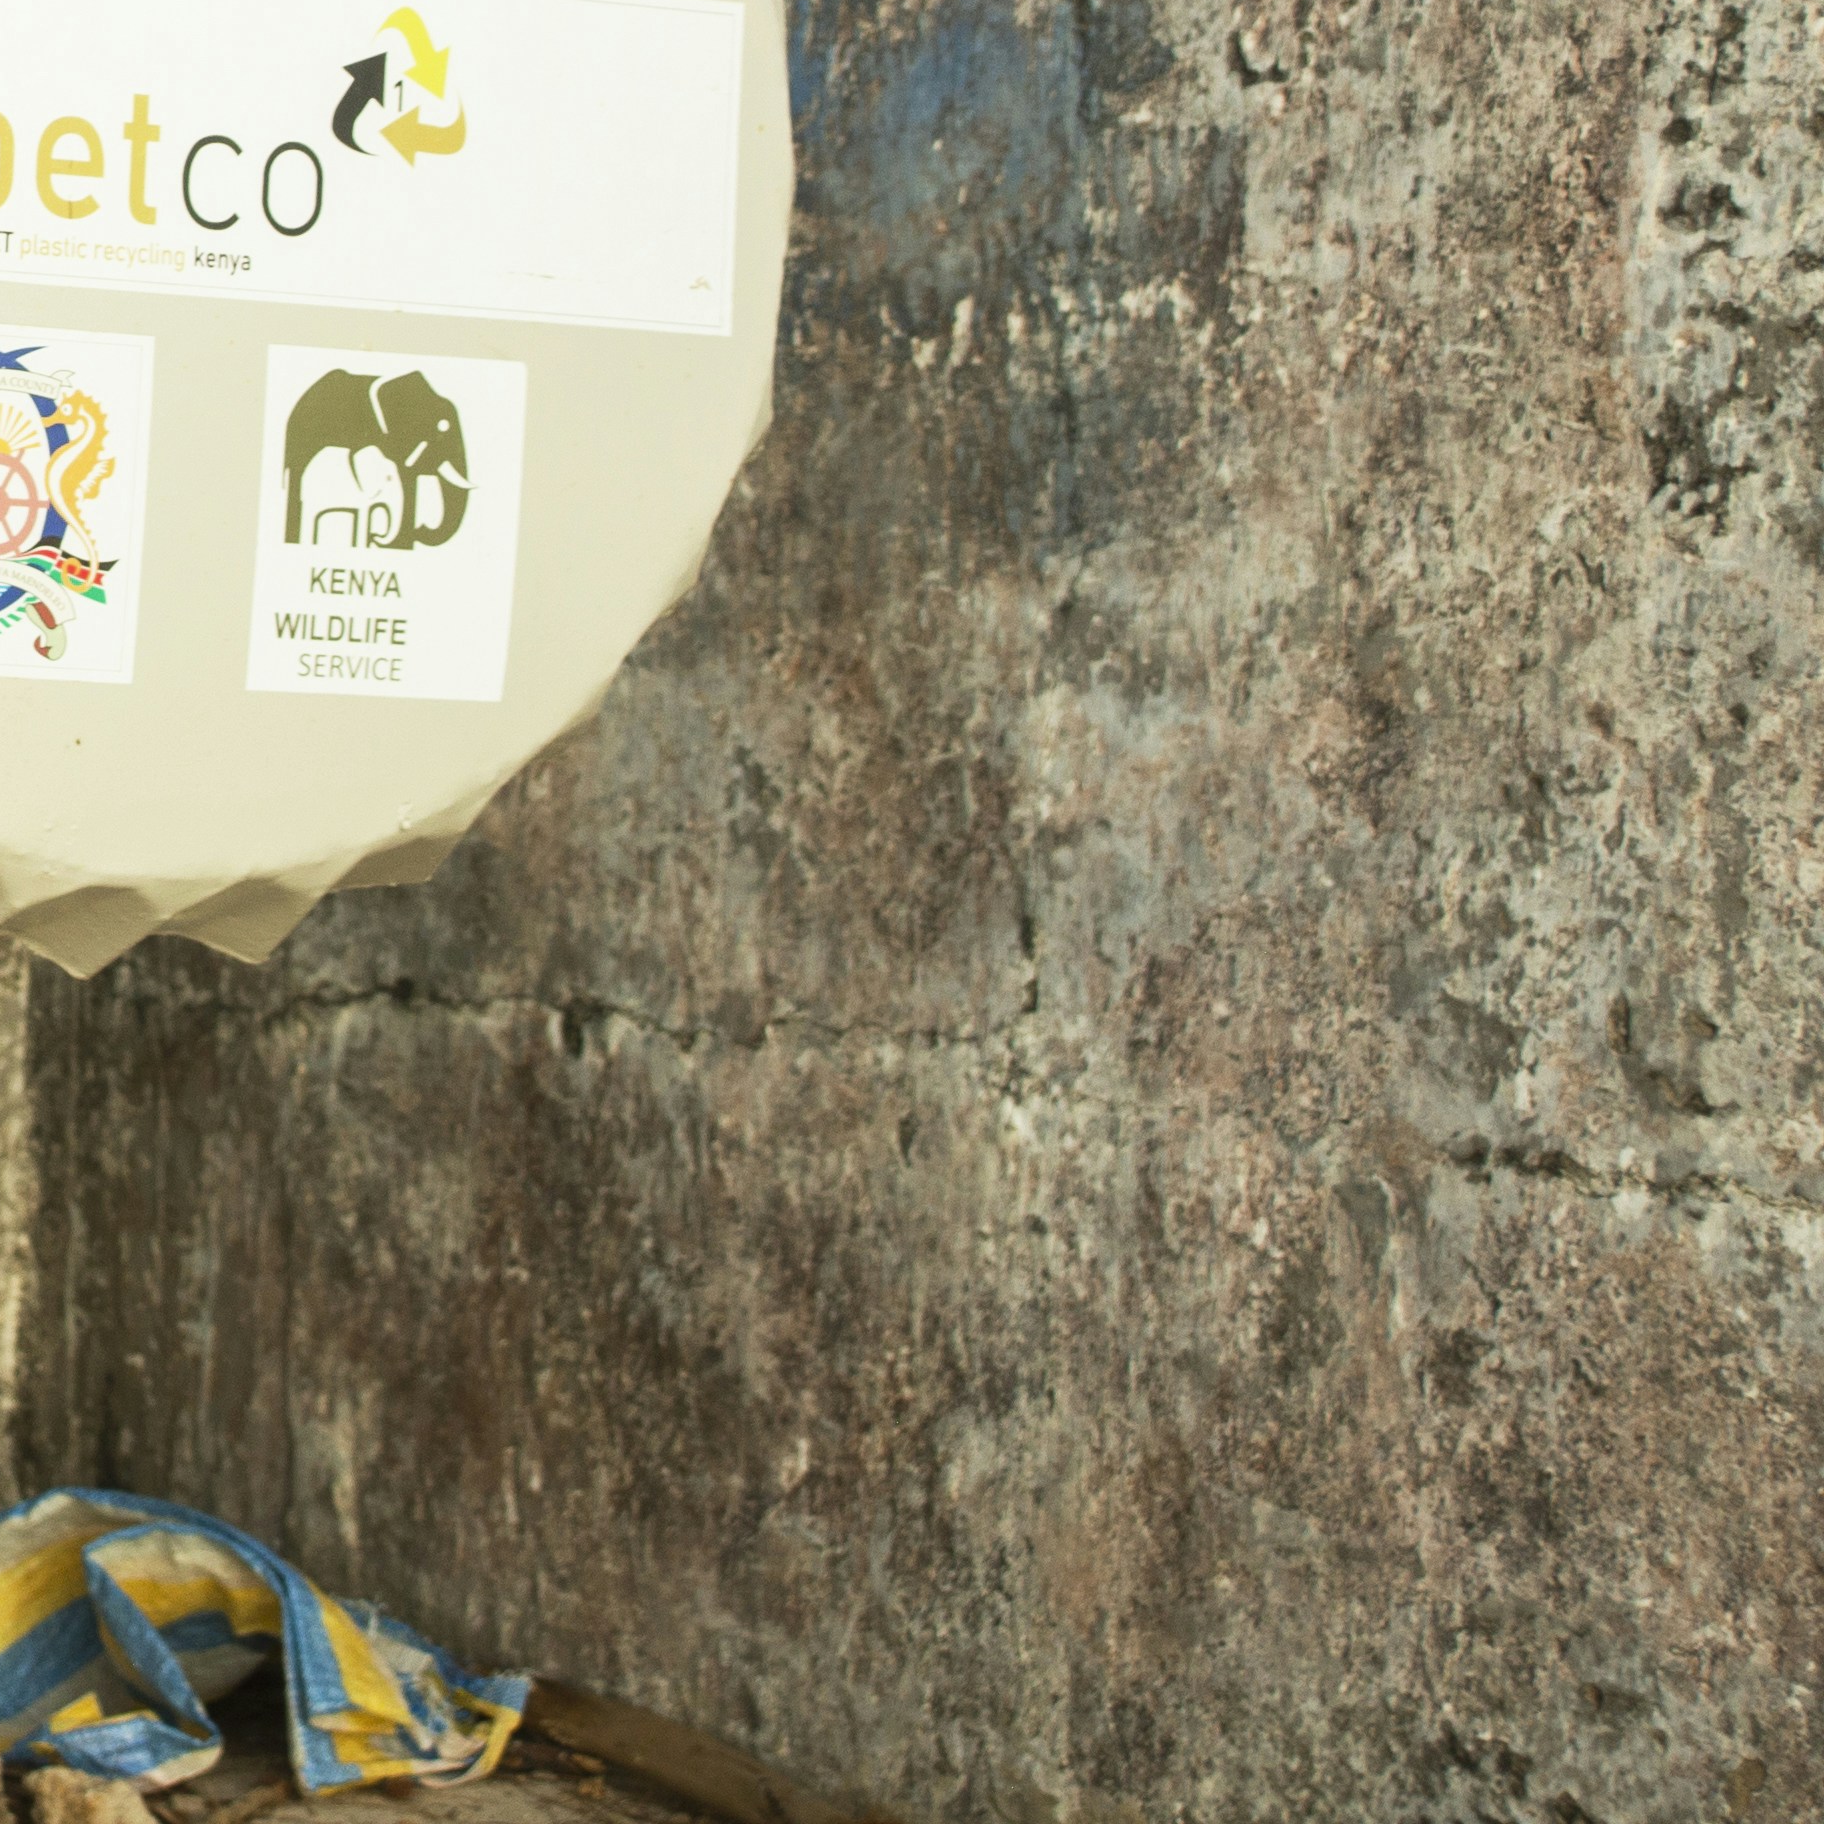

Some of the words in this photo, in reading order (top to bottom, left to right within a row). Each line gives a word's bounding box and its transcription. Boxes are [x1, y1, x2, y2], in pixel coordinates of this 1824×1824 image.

[19, 233, 88, 259] plastic
[93, 242, 186, 272] recycling
[194, 246, 252, 275] kenya
[9, 377, 57, 395] COUNTY
[309, 567, 402, 598] KENYA
[274, 612, 408, 645] WILDLIFE
[297, 653, 403, 681] SERVICE
